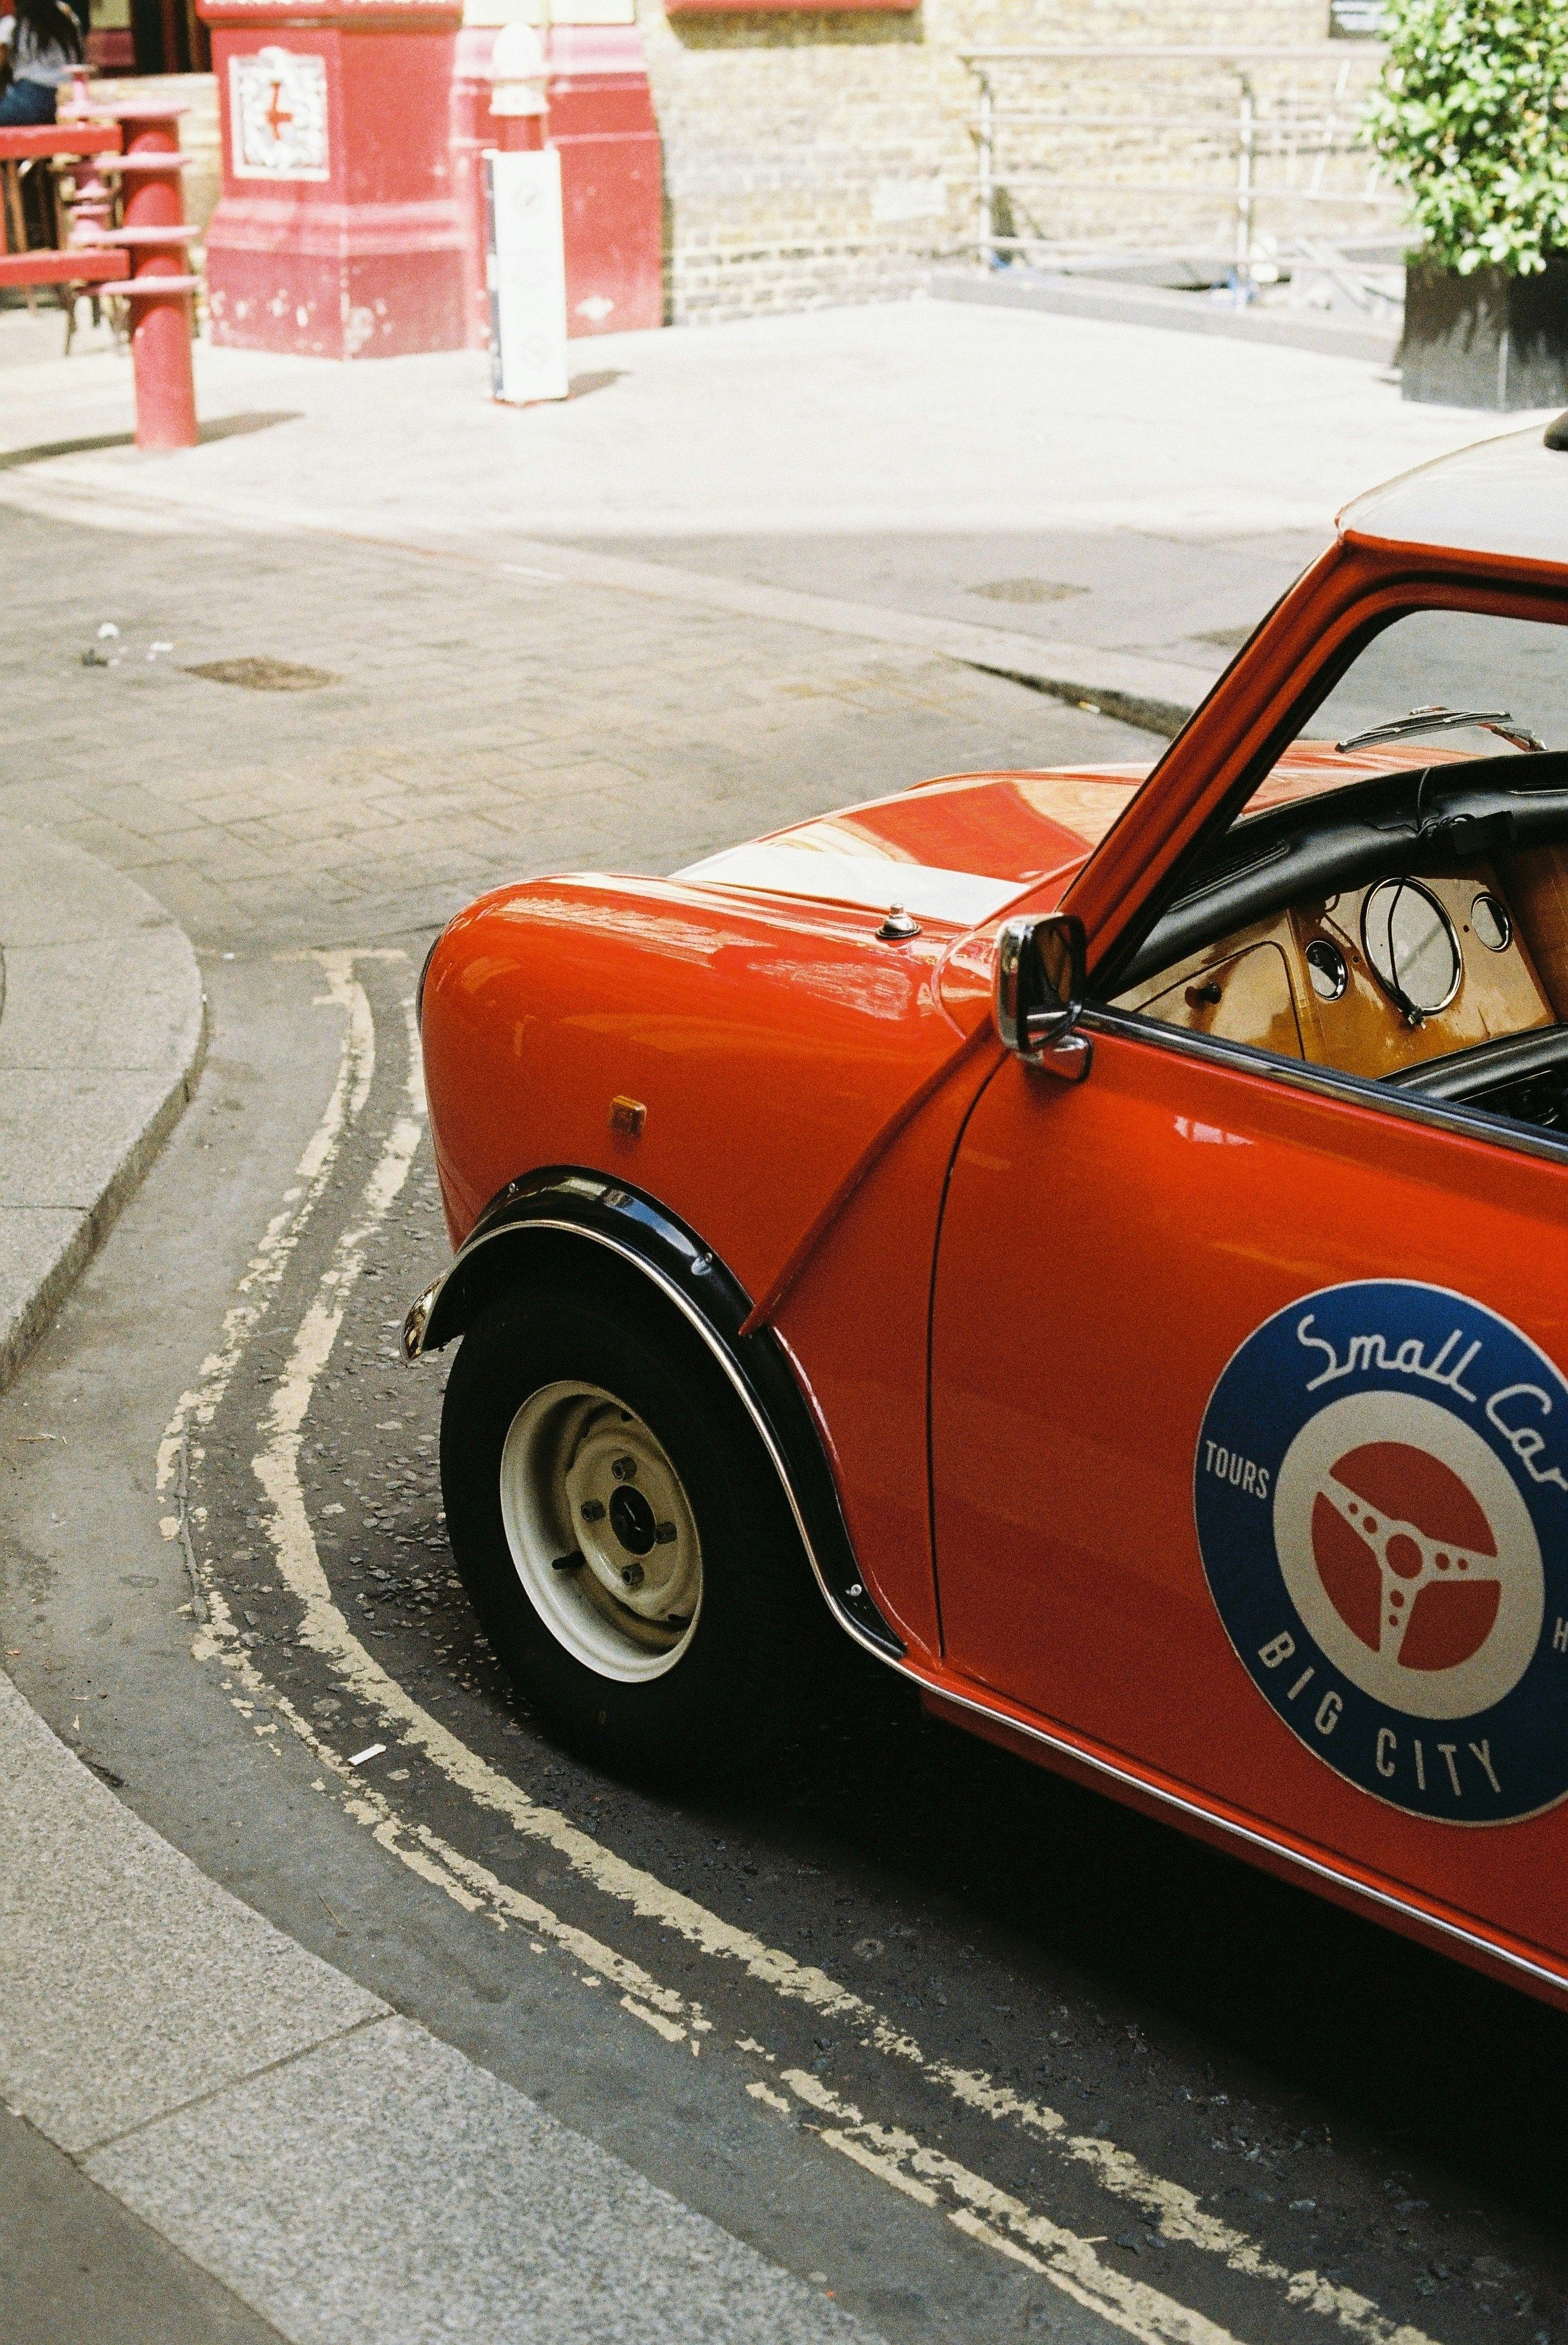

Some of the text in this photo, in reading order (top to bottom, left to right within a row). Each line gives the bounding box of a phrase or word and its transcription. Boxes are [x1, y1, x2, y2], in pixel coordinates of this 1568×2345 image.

[1297, 1314, 1482, 1403] Small
[1206, 1440, 1271, 1499] TOURS
[1259, 1631, 1501, 1796] BIG CITY
